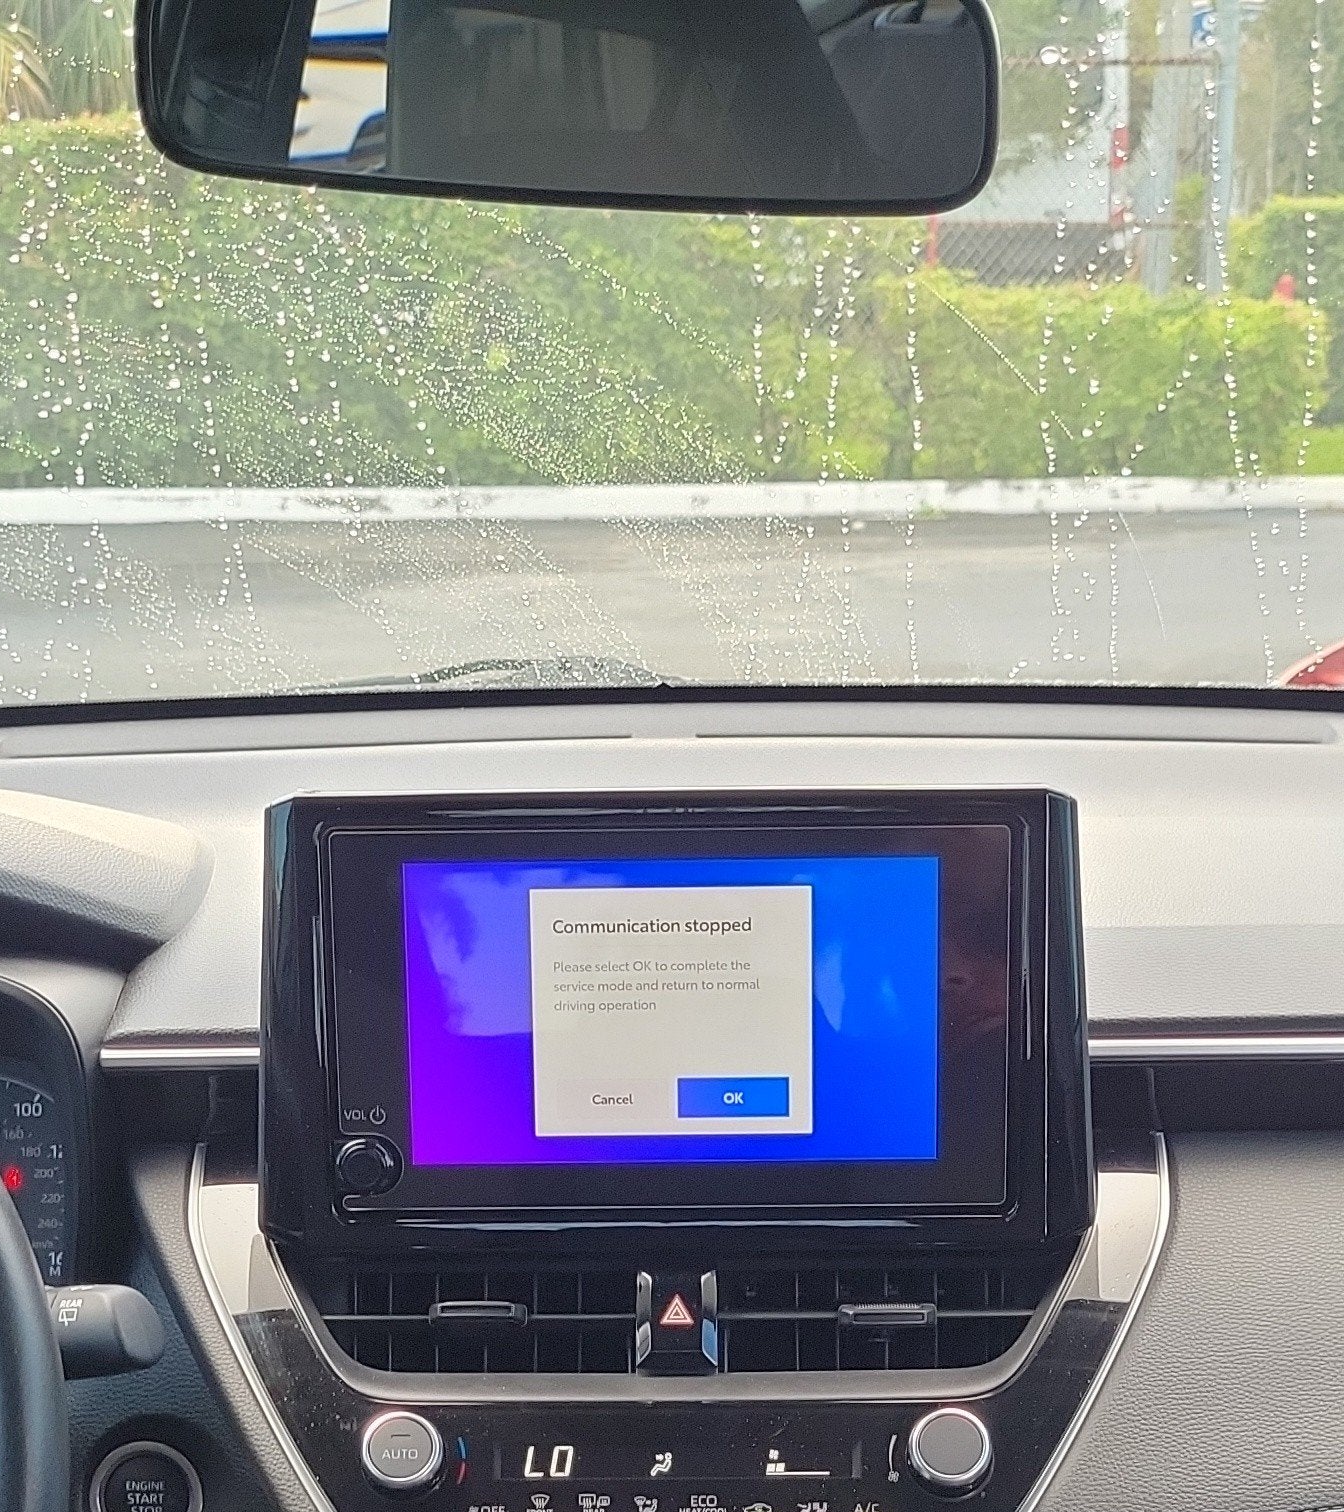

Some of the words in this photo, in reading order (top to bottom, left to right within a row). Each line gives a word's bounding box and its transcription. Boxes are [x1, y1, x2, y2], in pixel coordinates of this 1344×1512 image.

[552, 917, 681, 935] Communication
[684, 916, 753, 936] stopped
[553, 960, 592, 974] Please
[594, 960, 630, 973] select
[632, 960, 652, 973] OK
[654, 960, 668, 972] to
[670, 959, 728, 975] complete
[730, 959, 751, 972] the
[553, 980, 595, 993] service
[597, 979, 633, 992] mode
[635, 979, 659, 992] and
[661, 979, 698, 991] return
[701, 979, 715, 991] to
[716, 978, 761, 991] normal
[553, 1000, 596, 1014] driving
[598, 999, 657, 1014] operation
[591, 1092, 634, 1107] Cancel
[722, 1092, 744, 1106] OK
[13, 1102, 43, 1118] 100
[343, 1109, 367, 1121] VOL
[59, 1298, 83, 1308] REAR
[381, 1448, 419, 1461] AUTO
[523, 1444, 574, 1478] LO
[125, 1480, 165, 1492] ENGINE
[127, 1493, 165, 1505] START
[690, 1495, 718, 1507] ECO
